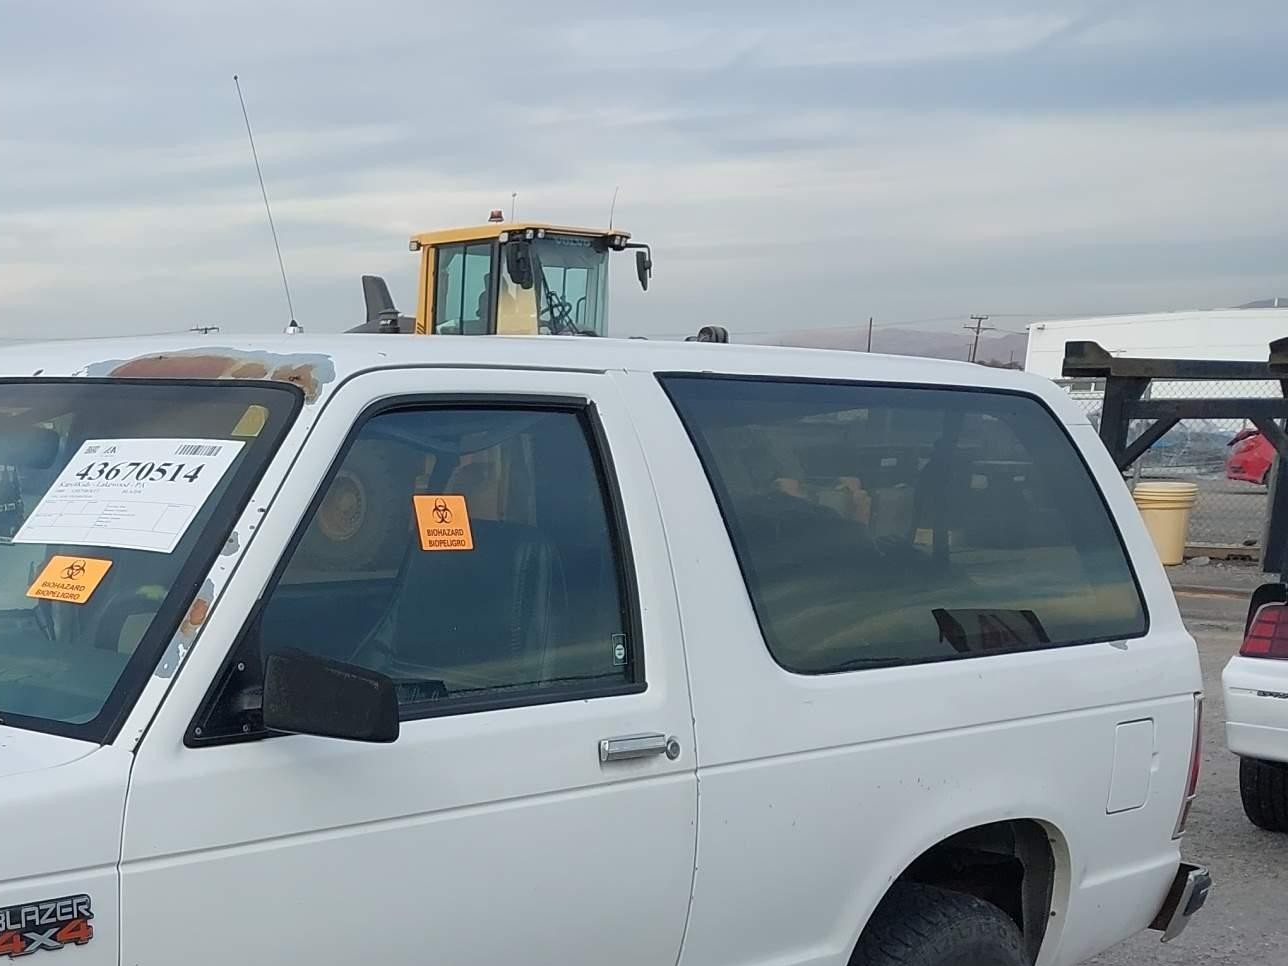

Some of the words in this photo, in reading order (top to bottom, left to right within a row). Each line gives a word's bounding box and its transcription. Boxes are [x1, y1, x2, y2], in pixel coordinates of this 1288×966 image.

[75, 461, 206, 483] 43670514
[426, 528, 464, 537] BIOHAZARD
[428, 539, 466, 548] BIOPELIGRO
[41, 580, 85, 592] BIOHAZARD
[35, 589, 80, 601] BIOPELIGRO
